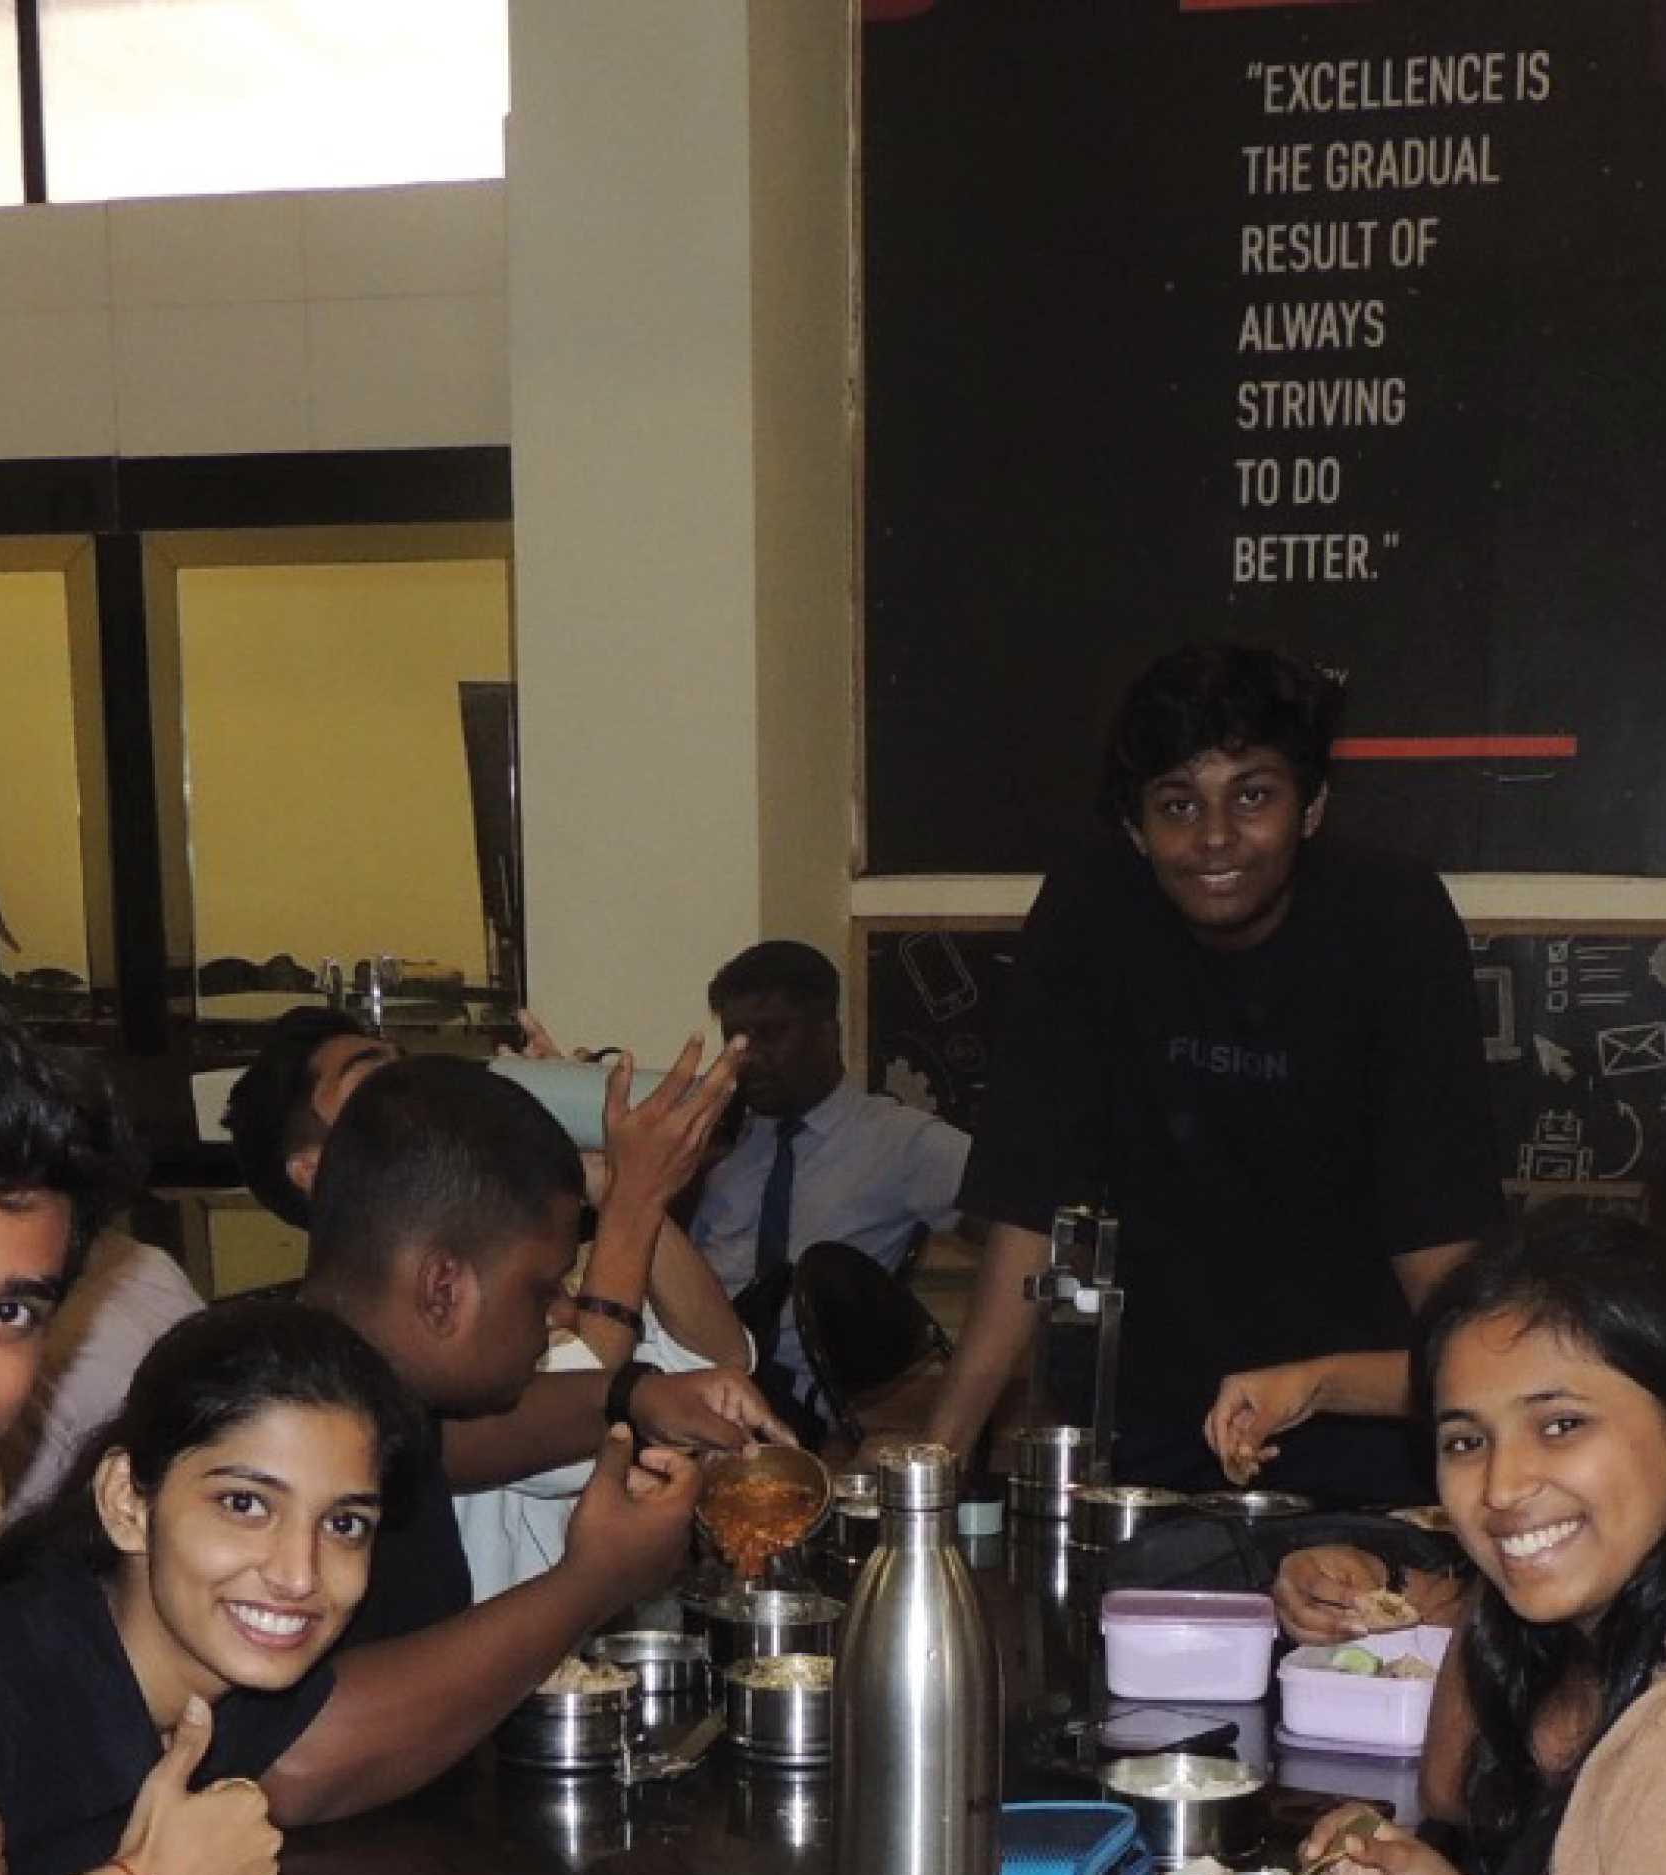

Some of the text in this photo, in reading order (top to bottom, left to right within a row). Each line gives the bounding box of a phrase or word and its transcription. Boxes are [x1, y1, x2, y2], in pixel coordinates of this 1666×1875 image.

[1516, 49, 1550, 101] IS
[1241, 134, 1500, 195] THE GRADUAL
[1241, 217, 1439, 273] RESULT OF
[1238, 299, 1384, 352] ALWAYS
[1236, 377, 1406, 429] STRIVING
[1234, 455, 1340, 507] TO DO
[1167, 1036, 1289, 1081] FUSION
